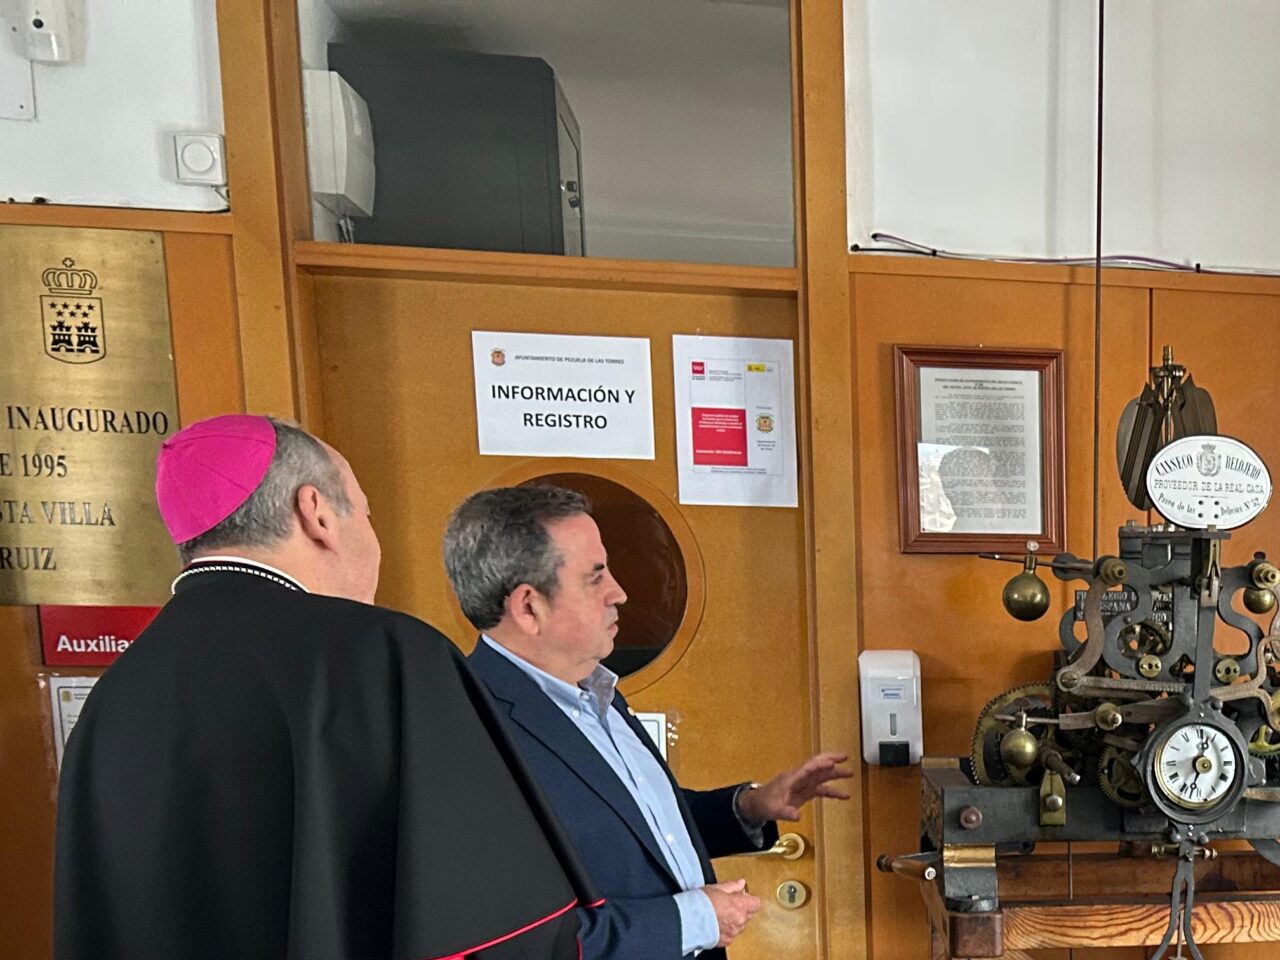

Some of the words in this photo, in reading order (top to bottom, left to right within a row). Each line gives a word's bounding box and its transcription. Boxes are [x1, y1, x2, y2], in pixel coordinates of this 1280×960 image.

[491, 384, 620, 404] INFORMACIÓN
[625, 389, 635, 404] Y
[7, 406, 168, 435] INAUGURADO
[523, 413, 608, 430] REGISTRO
[21, 453, 68, 478] 1995
[1154, 479, 1198, 491] PROVEEDOR
[0, 500, 33, 525] TA
[41, 501, 116, 526] VILLA
[0, 547, 57, 571] RUIZ
[57, 635, 134, 653] Auxilia
